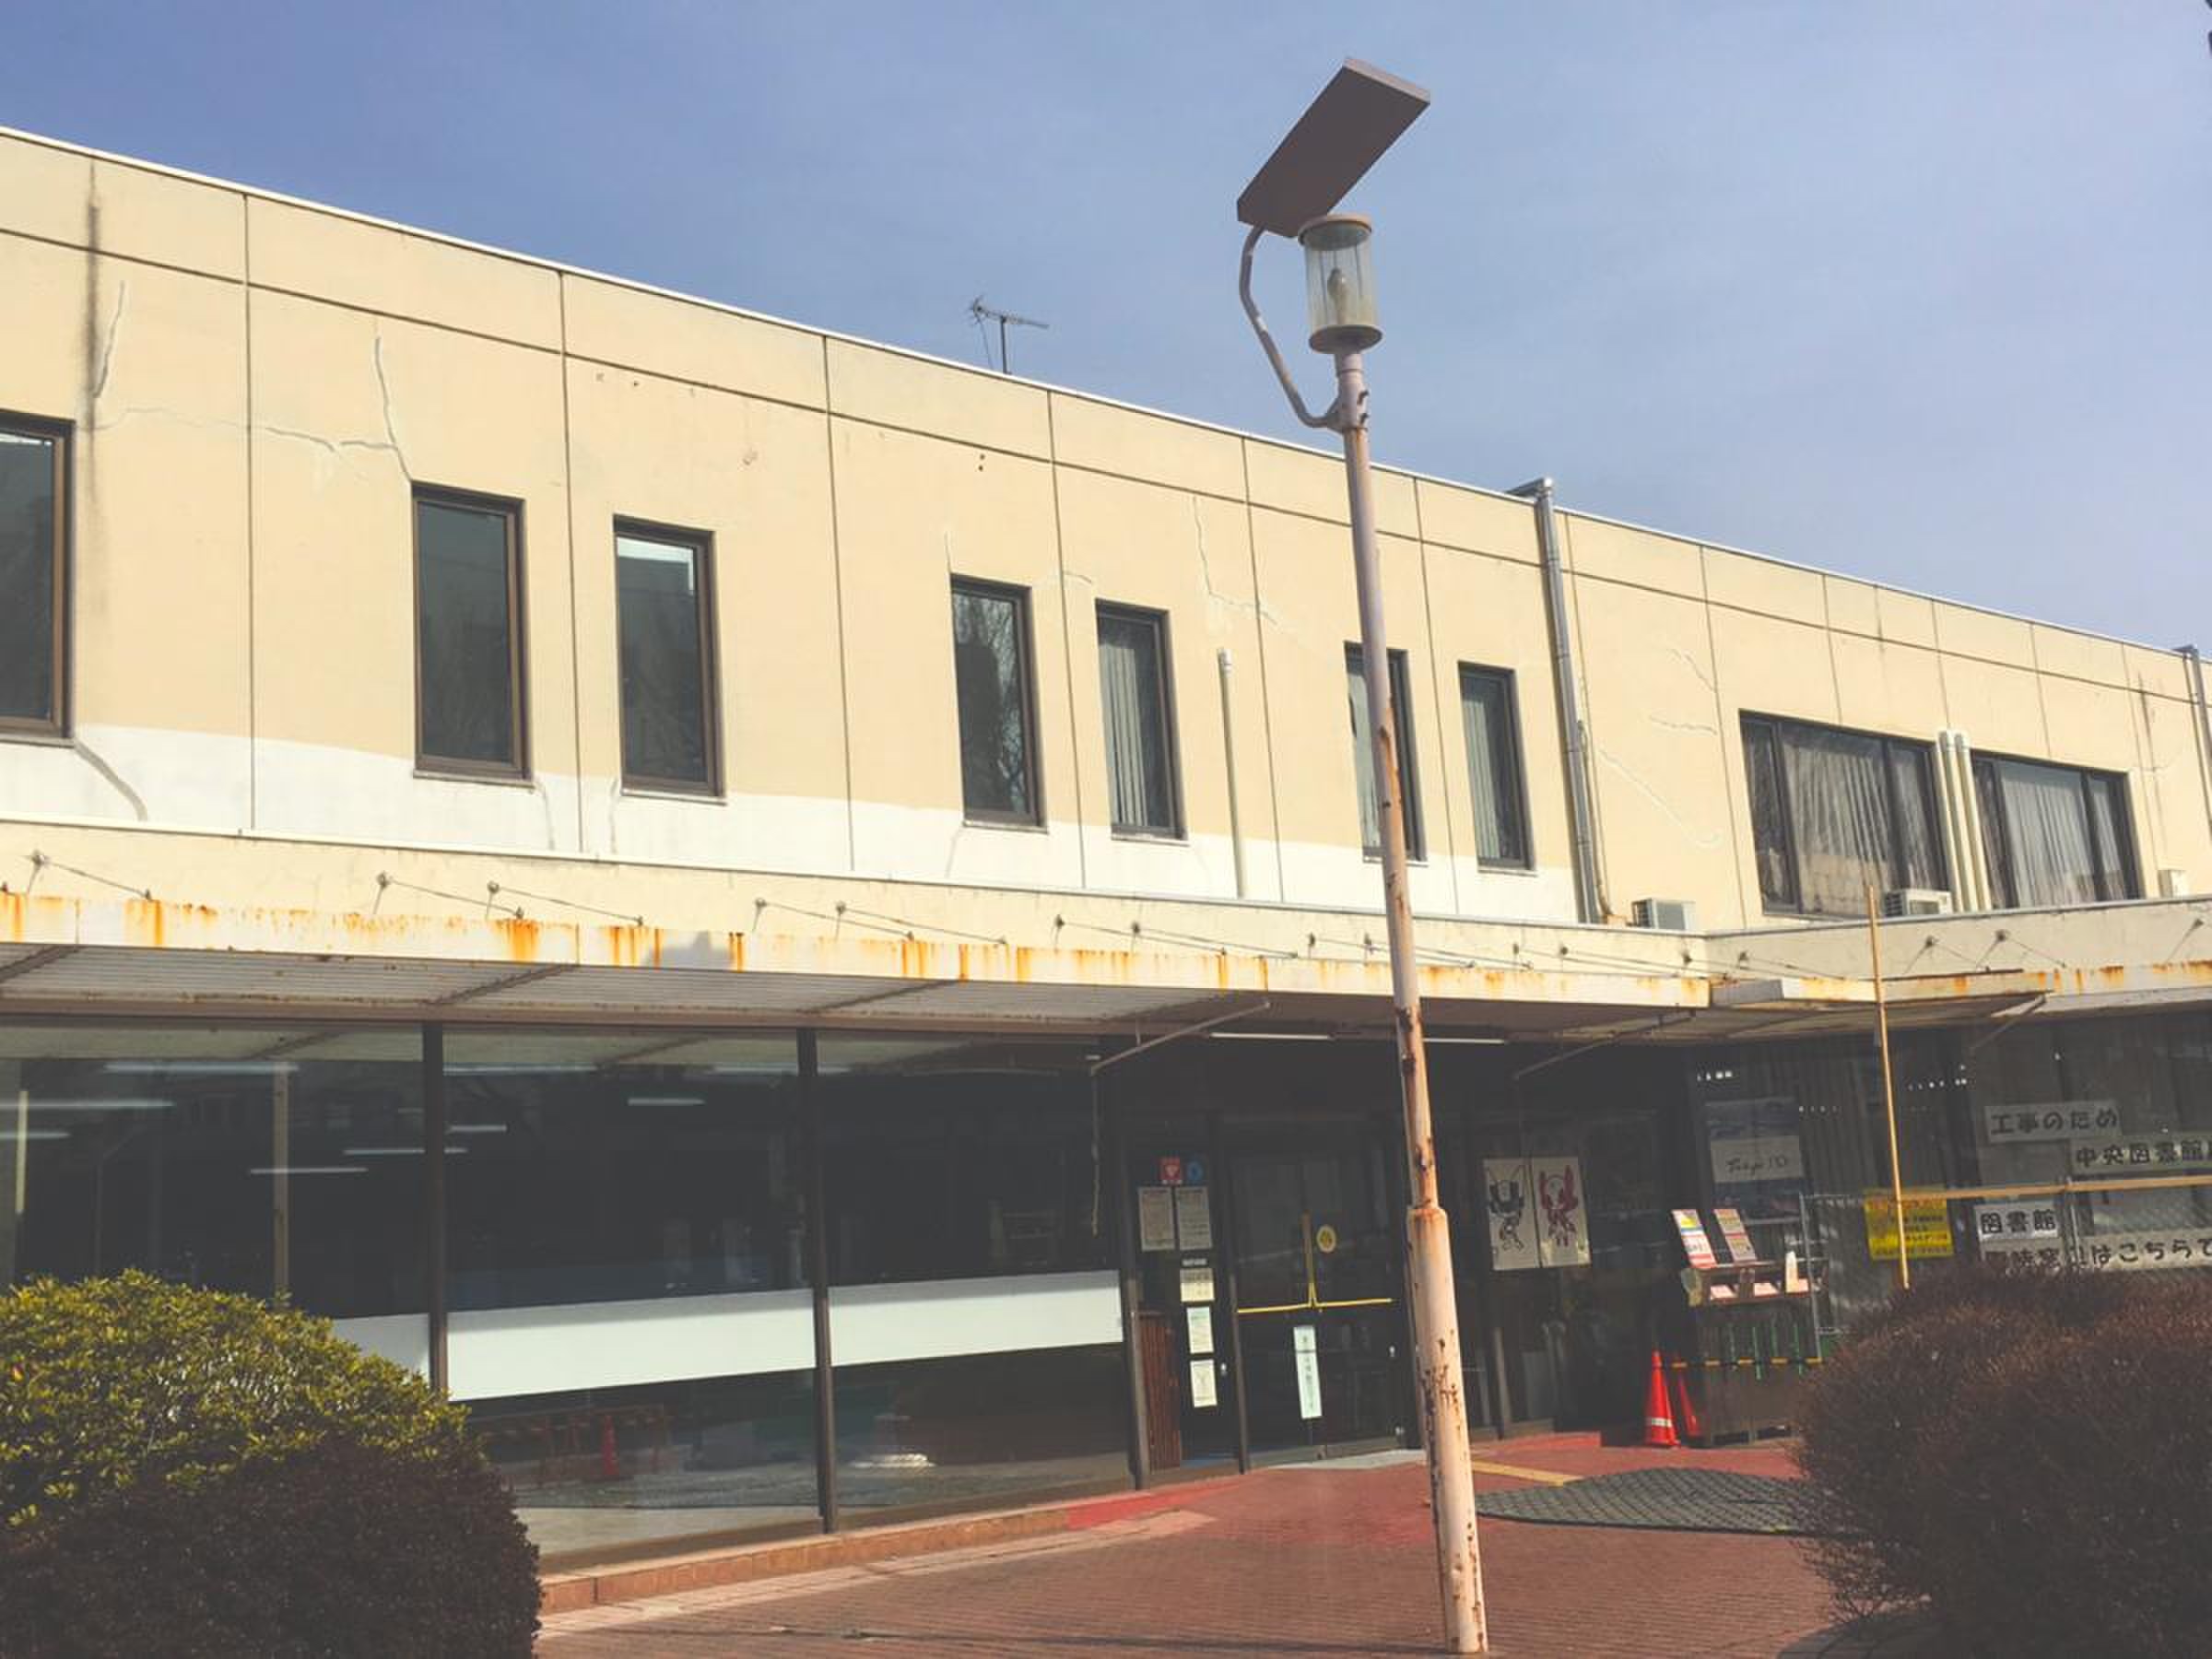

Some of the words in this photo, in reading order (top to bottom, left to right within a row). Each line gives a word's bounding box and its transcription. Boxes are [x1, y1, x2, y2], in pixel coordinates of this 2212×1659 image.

[1991, 1107, 2117, 1135] 工事のため
[2077, 1139, 2212, 1168] 中央図書館
[1981, 1209, 2056, 1234] 図書館
